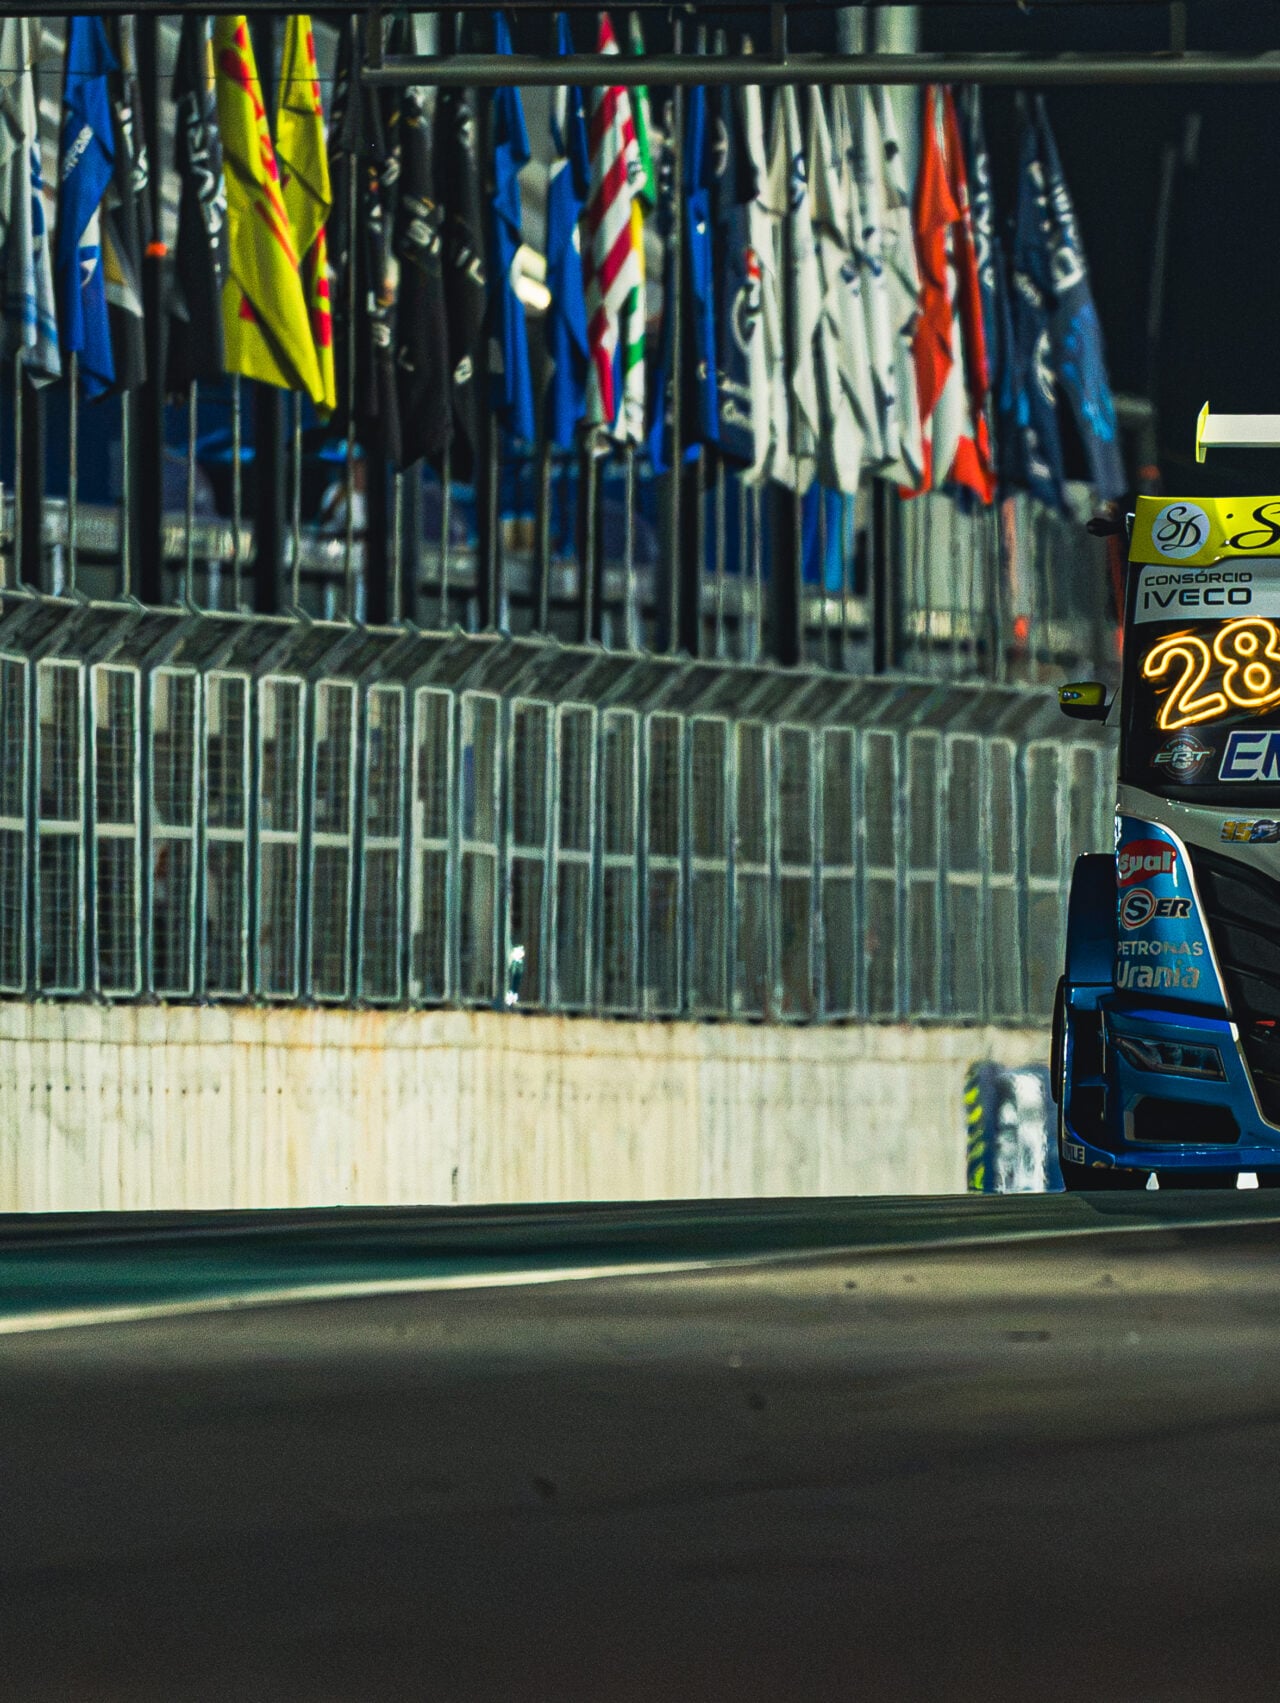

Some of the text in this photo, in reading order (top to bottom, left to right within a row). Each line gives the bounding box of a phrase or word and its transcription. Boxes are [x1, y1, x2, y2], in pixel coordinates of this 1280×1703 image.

[1144, 571, 1253, 587] CONSÓRCIO
[1144, 587, 1253, 609] IVECO
[1119, 851, 1173, 880] sual
[1122, 892, 1193, 926] SER
